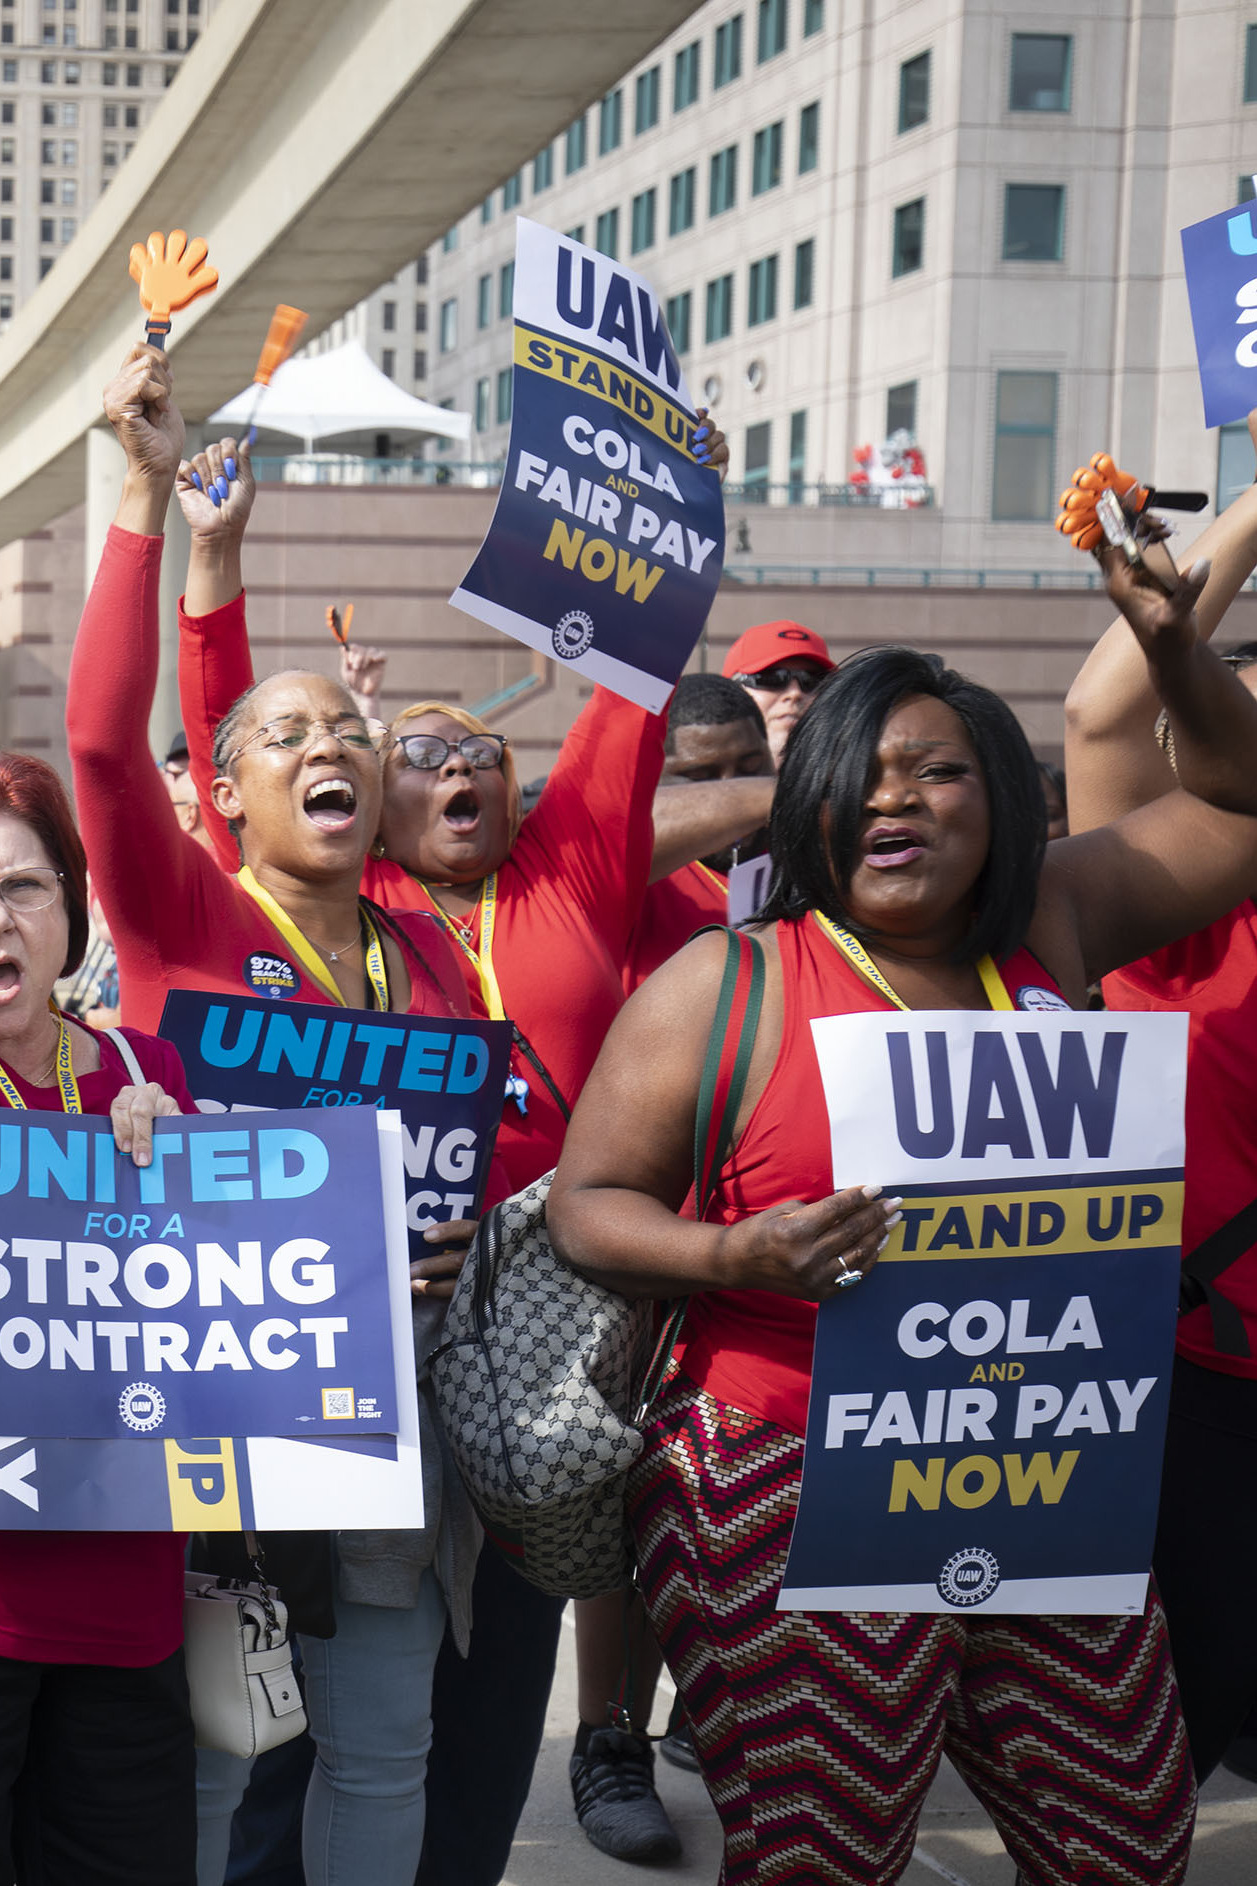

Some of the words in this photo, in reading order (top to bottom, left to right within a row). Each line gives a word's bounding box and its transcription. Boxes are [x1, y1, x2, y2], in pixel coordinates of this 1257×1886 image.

[555, 244, 682, 392] UAW
[527, 340, 655, 421] STAND
[562, 415, 685, 504] COLA
[605, 474, 640, 499] AND
[514, 450, 622, 535] FAIR
[628, 506, 717, 574] PAY
[542, 519, 666, 604] NOW
[829, 919, 867, 963] CONTR
[250, 956, 292, 974] 97%
[251, 970, 280, 978] READY
[252, 976, 296, 988] STRIKE
[369, 952, 381, 975] THE
[199, 1004, 490, 1095] UNITED
[60, 1070, 79, 1114] STRONG
[301, 1087, 365, 1107] FOR
[886, 1030, 1129, 1160] UAW
[83, 1212, 152, 1239] FOR
[158, 1213, 185, 1239] A
[898, 1201, 1067, 1252] TAND
[1087, 1194, 1165, 1243] UP
[897, 1295, 1104, 1360] COLA
[969, 1361, 1026, 1384] AND
[131, 1401, 152, 1413] UAW
[357, 1404, 374, 1412] THE
[357, 1411, 383, 1419] FIGHT
[824, 1387, 999, 1450] FAIR
[1013, 1377, 1158, 1440] PAY
[888, 1450, 1081, 1514] NOW
[956, 1570, 983, 1583] UAW
